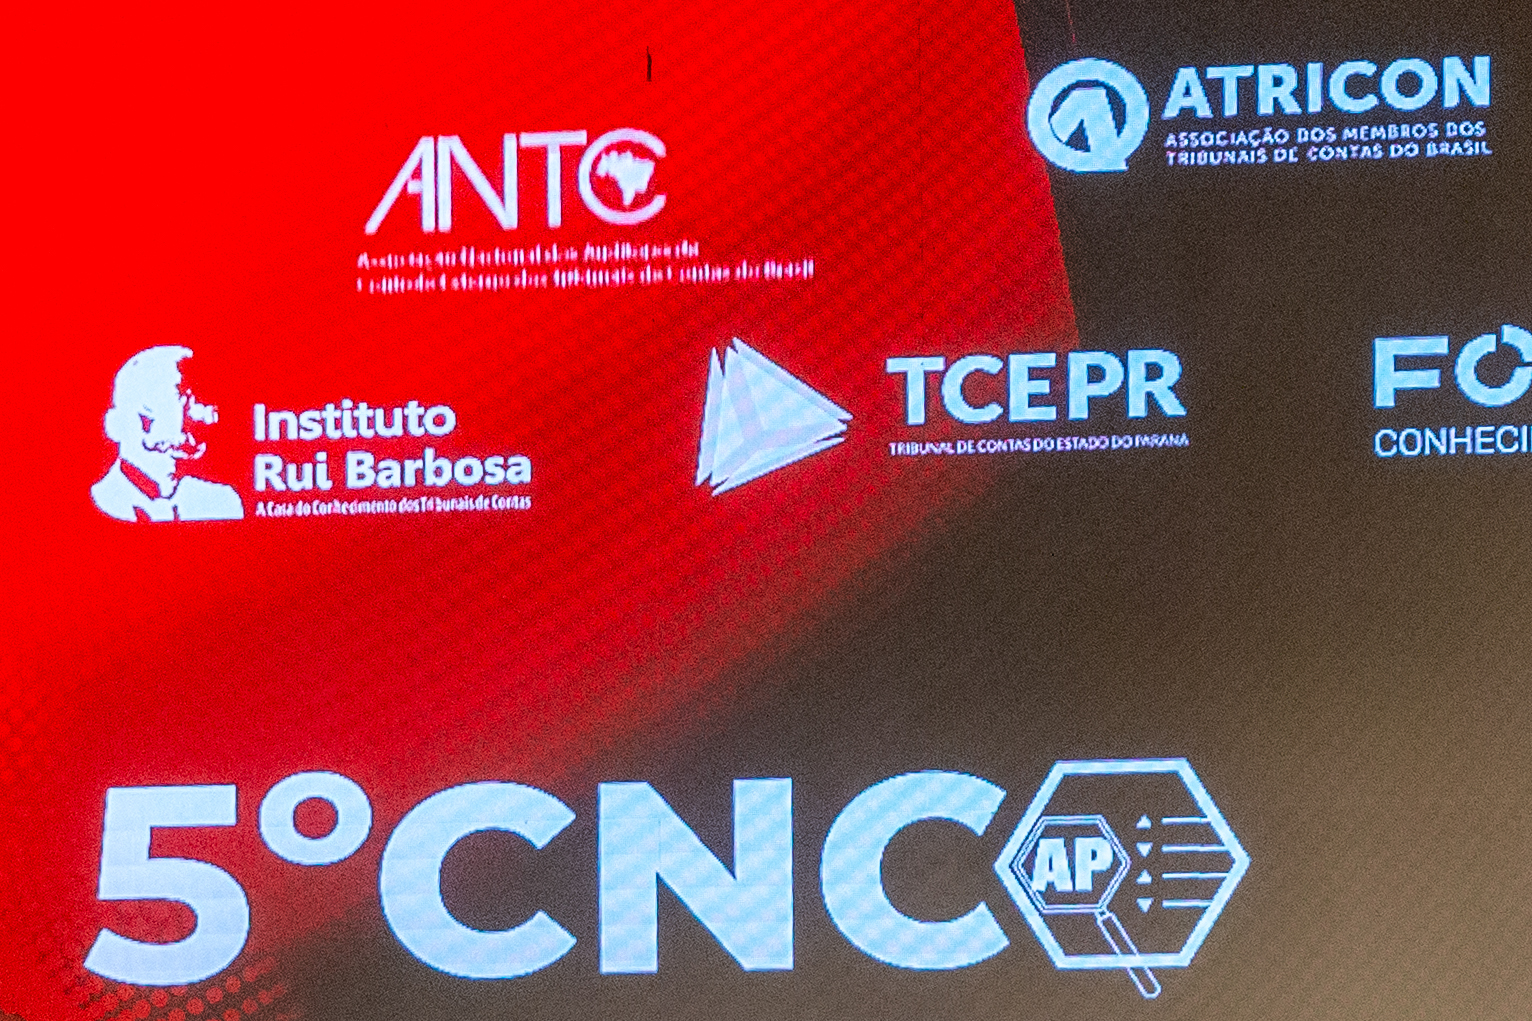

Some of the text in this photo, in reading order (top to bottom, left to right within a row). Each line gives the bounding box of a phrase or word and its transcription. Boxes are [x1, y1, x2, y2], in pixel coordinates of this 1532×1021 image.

[1162, 55, 1491, 119] ATRICON
[1164, 120, 1486, 148] ASSOCIAÇÃO DOS MEMBROS DOS
[365, 128, 666, 234] ANTC
[886, 349, 1187, 425] TCEPR
[253, 398, 457, 441] Instituto
[254, 447, 532, 492] Rui Barbosa
[1030, 837, 1114, 893] AP
